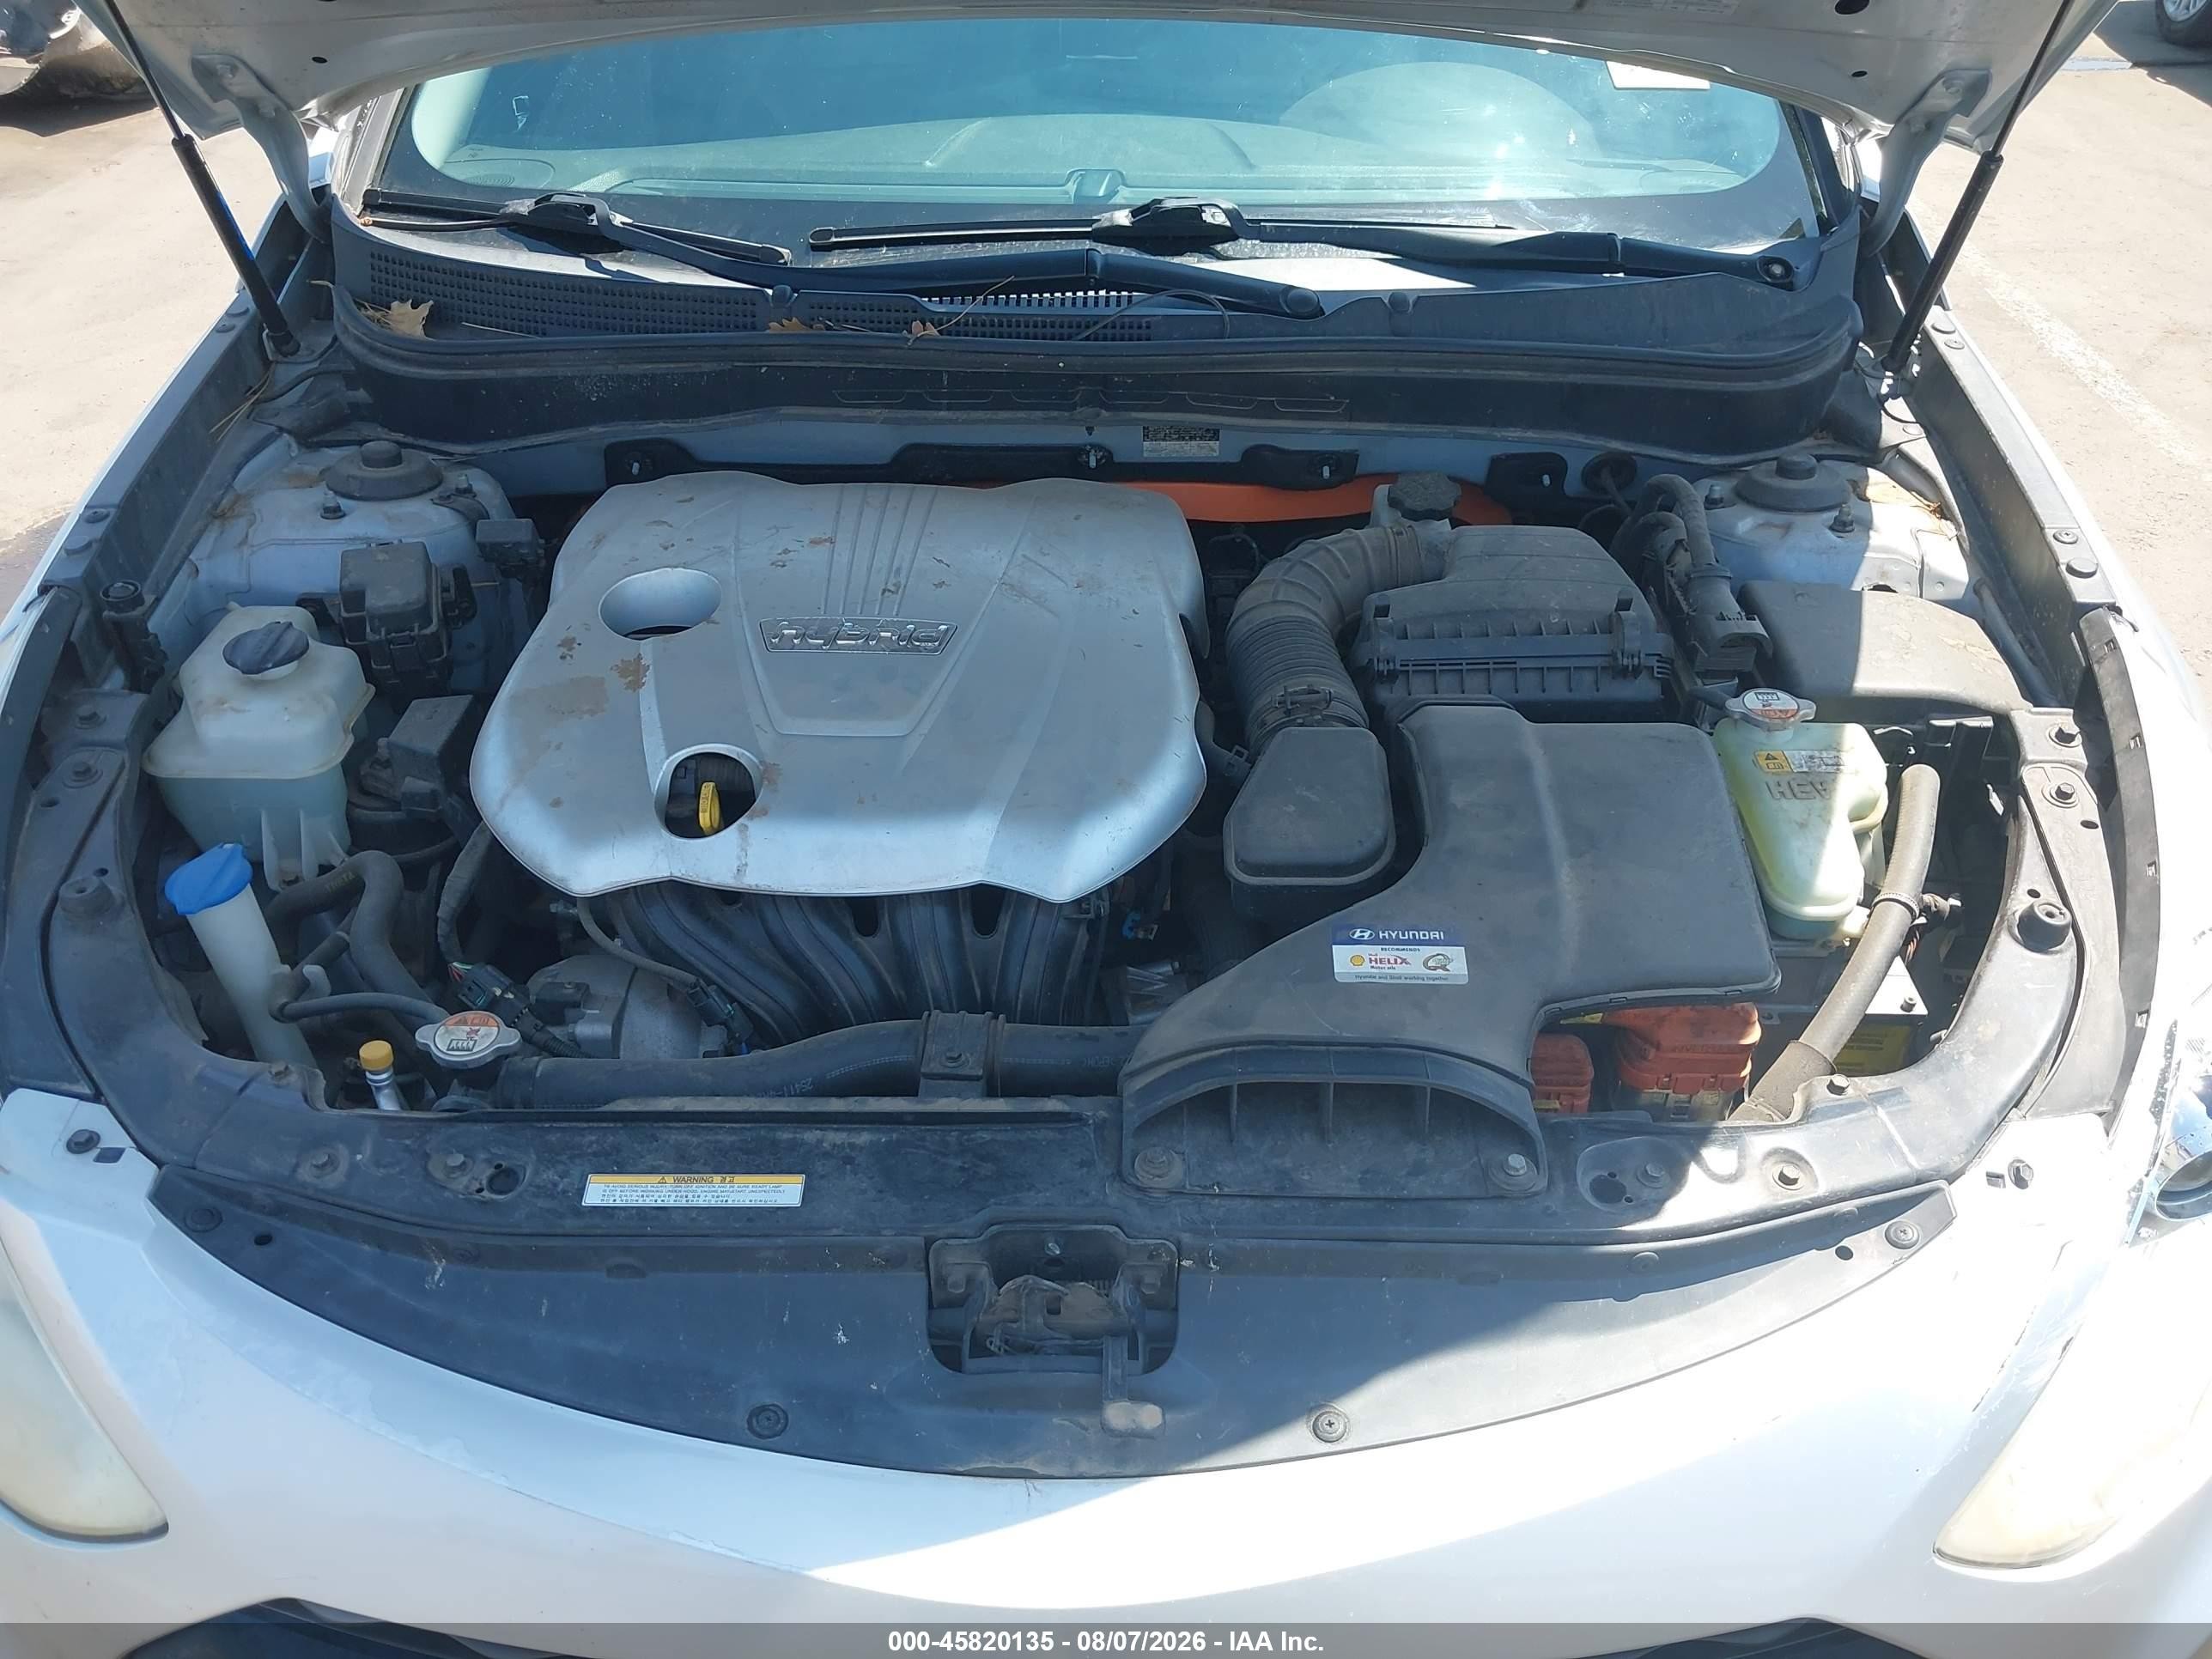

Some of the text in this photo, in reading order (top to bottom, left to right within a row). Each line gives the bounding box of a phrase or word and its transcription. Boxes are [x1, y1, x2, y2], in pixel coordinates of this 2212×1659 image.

[770, 622, 948, 649] hybrid
[1379, 930, 1444, 940] HYUNDAI
[1369, 957, 1411, 965] HELIX
